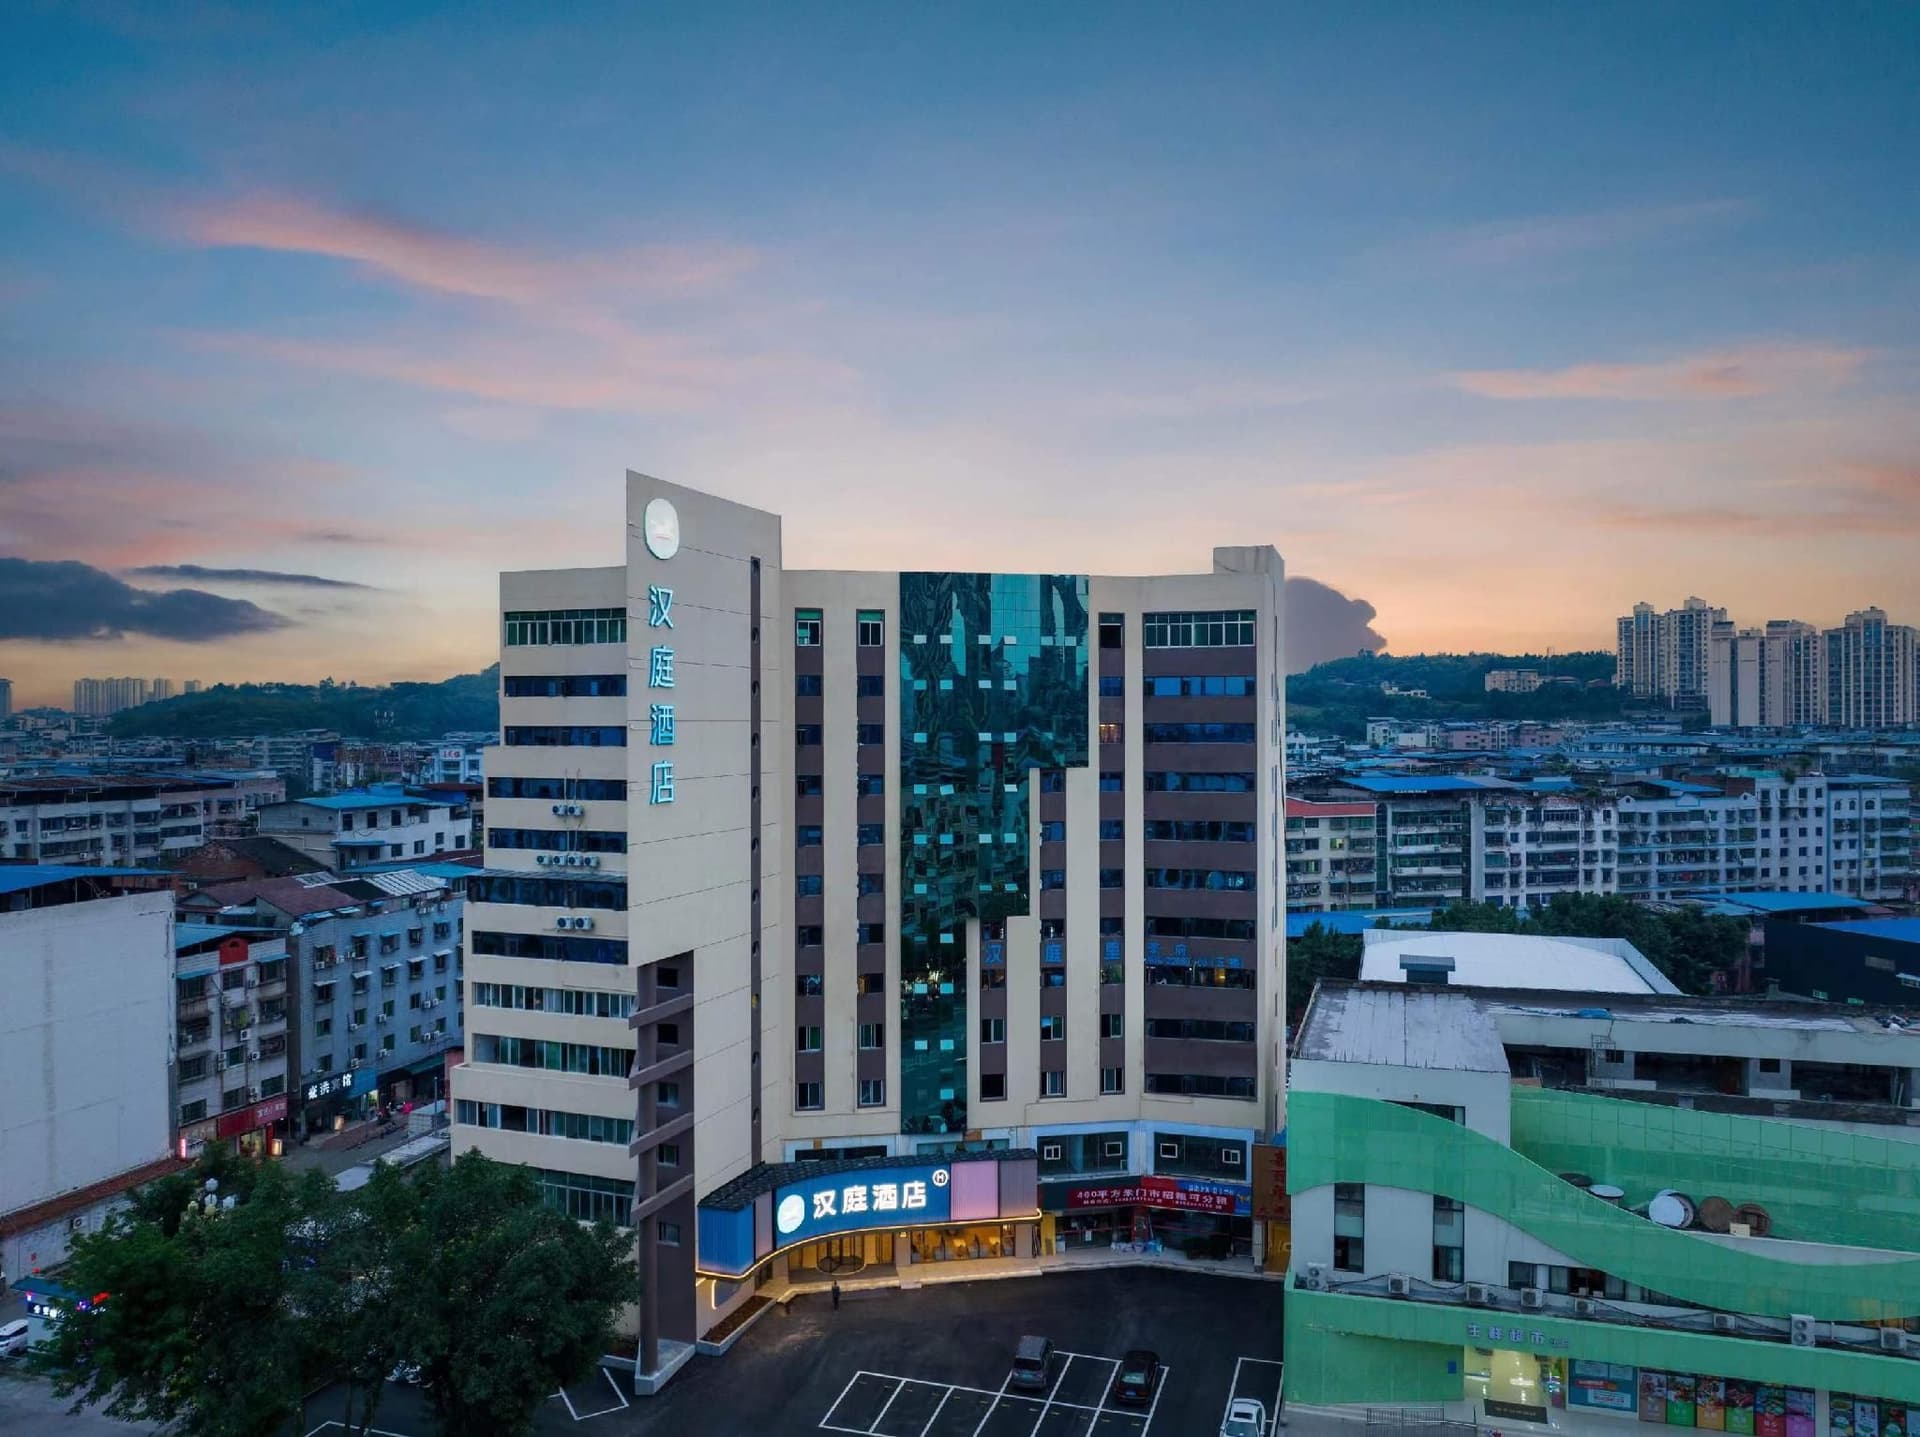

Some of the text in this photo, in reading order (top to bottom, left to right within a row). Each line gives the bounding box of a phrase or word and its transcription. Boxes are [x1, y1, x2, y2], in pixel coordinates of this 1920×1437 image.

[650, 585, 676, 804] 汉庭酒店
[813, 1180, 926, 1219] 汉庭酒店
